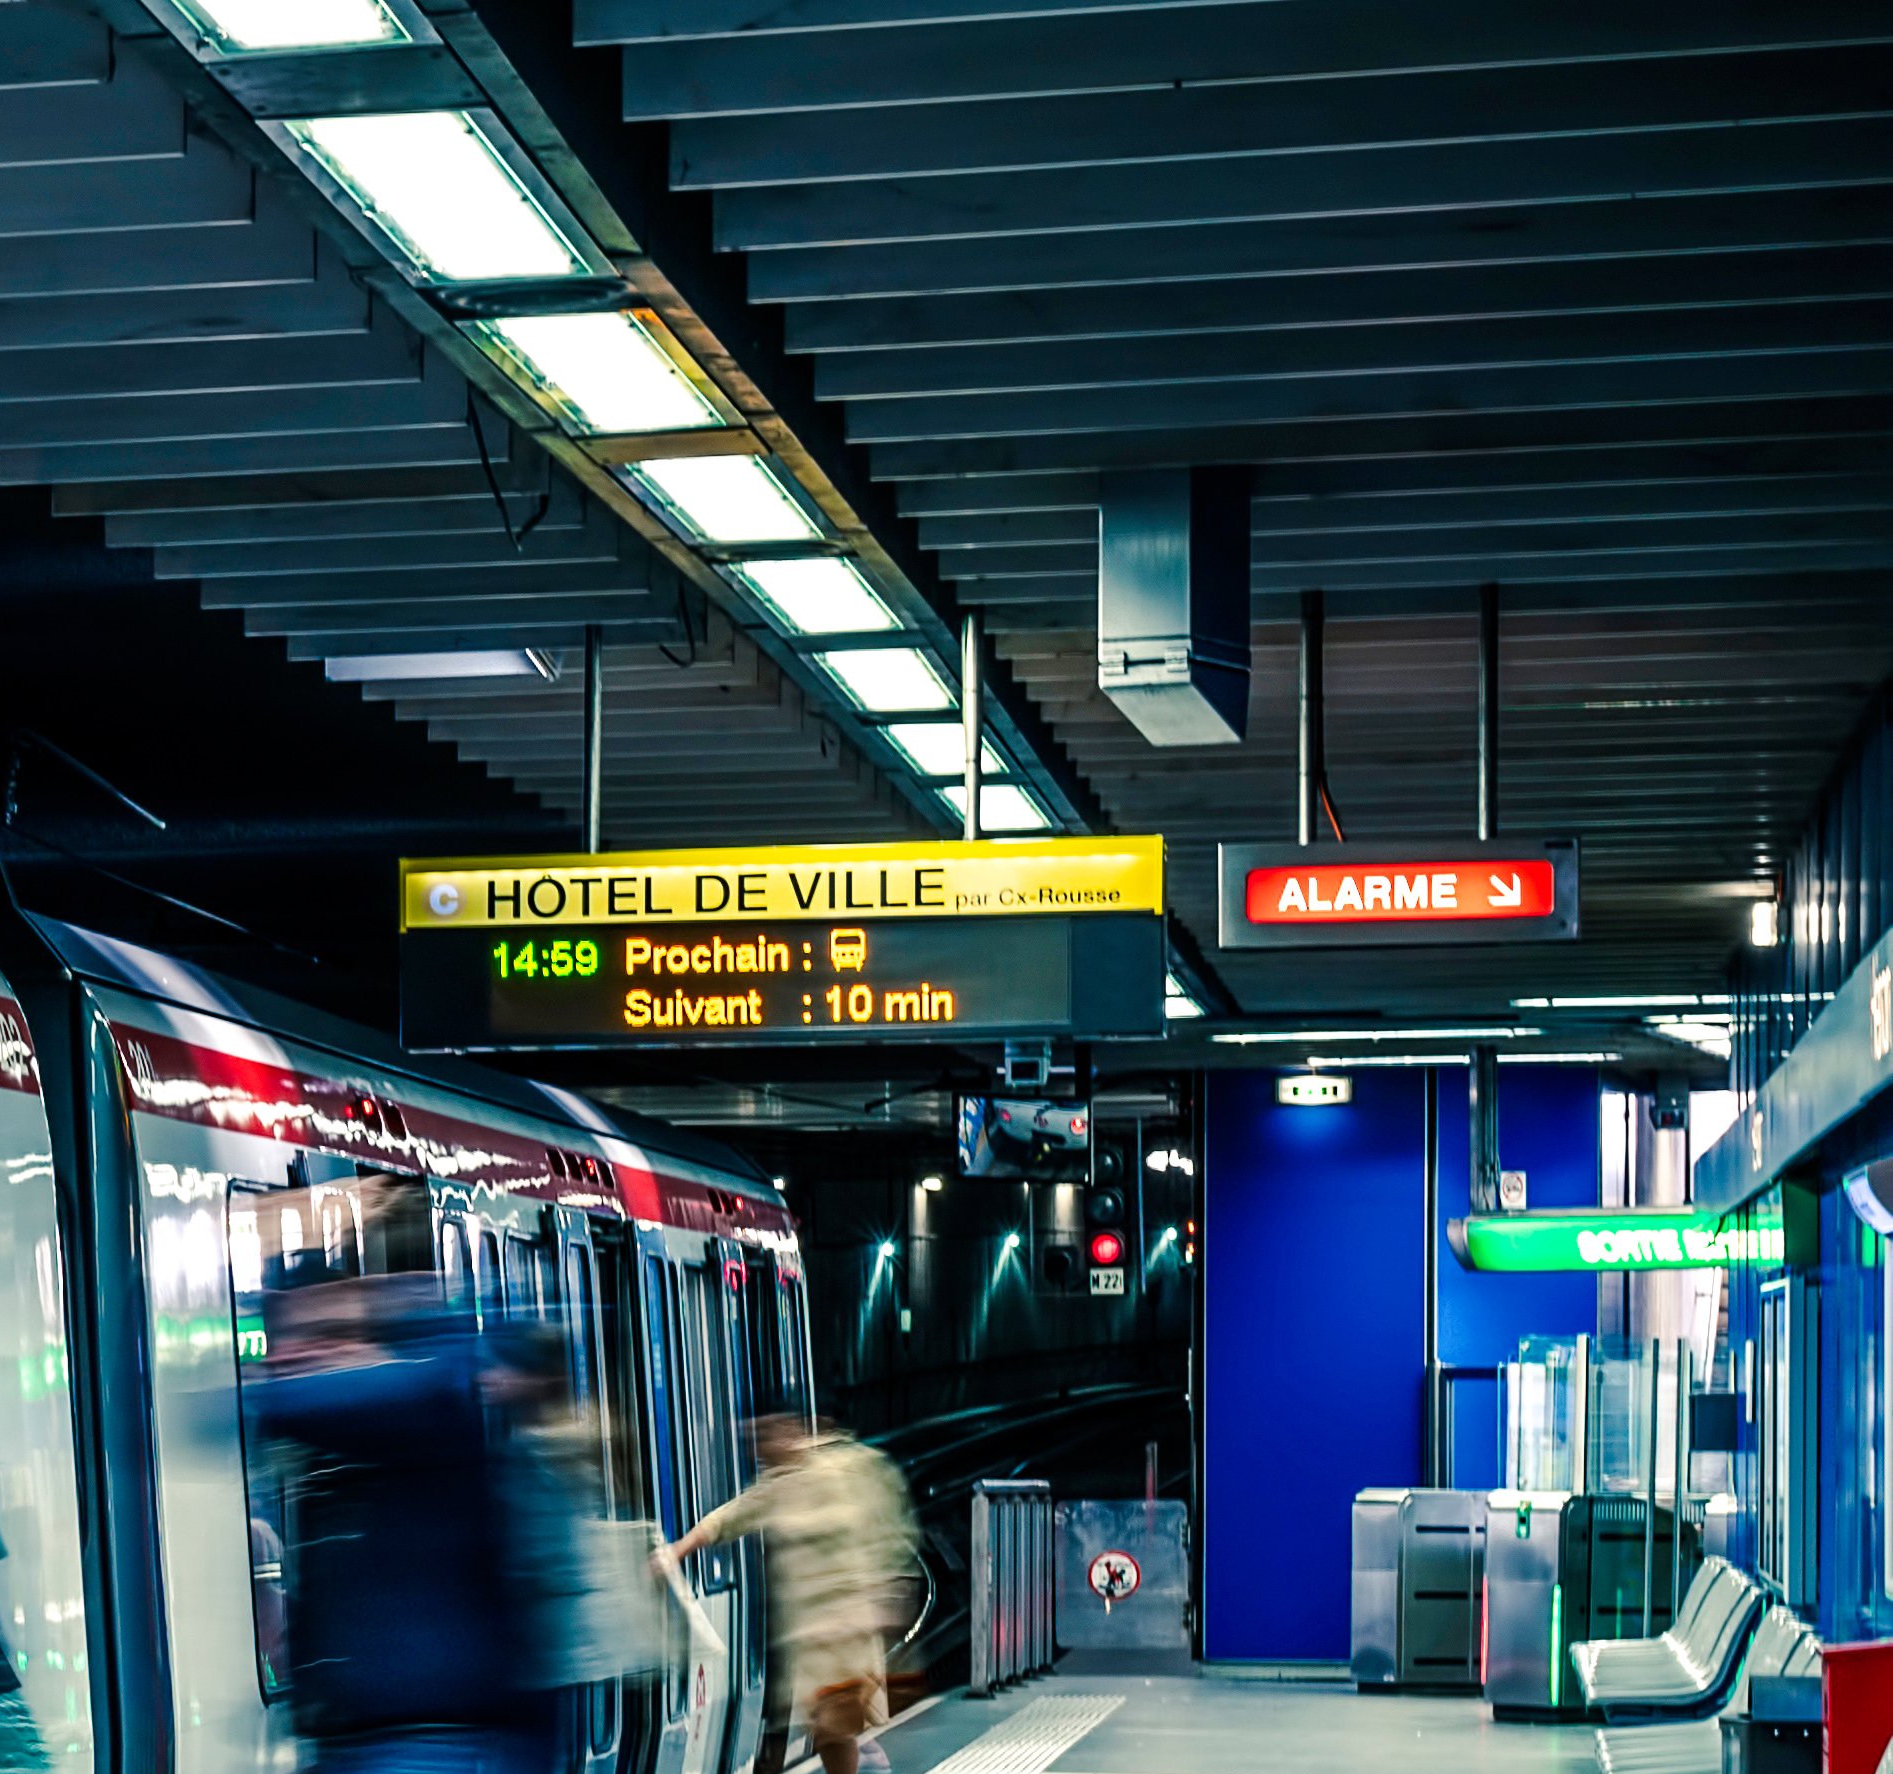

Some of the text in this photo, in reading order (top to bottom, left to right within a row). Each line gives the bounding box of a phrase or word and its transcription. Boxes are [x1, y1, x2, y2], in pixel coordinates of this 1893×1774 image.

[429, 868, 1121, 919] C HÔTEL DE VILLE par Cx-Rousse
[1278, 873, 1458, 913] ALARME
[493, 940, 599, 978] 14:59
[624, 935, 789, 975] Prochain
[623, 988, 762, 1027] Suivant
[825, 984, 873, 1023] 10
[884, 982, 955, 1023] min
